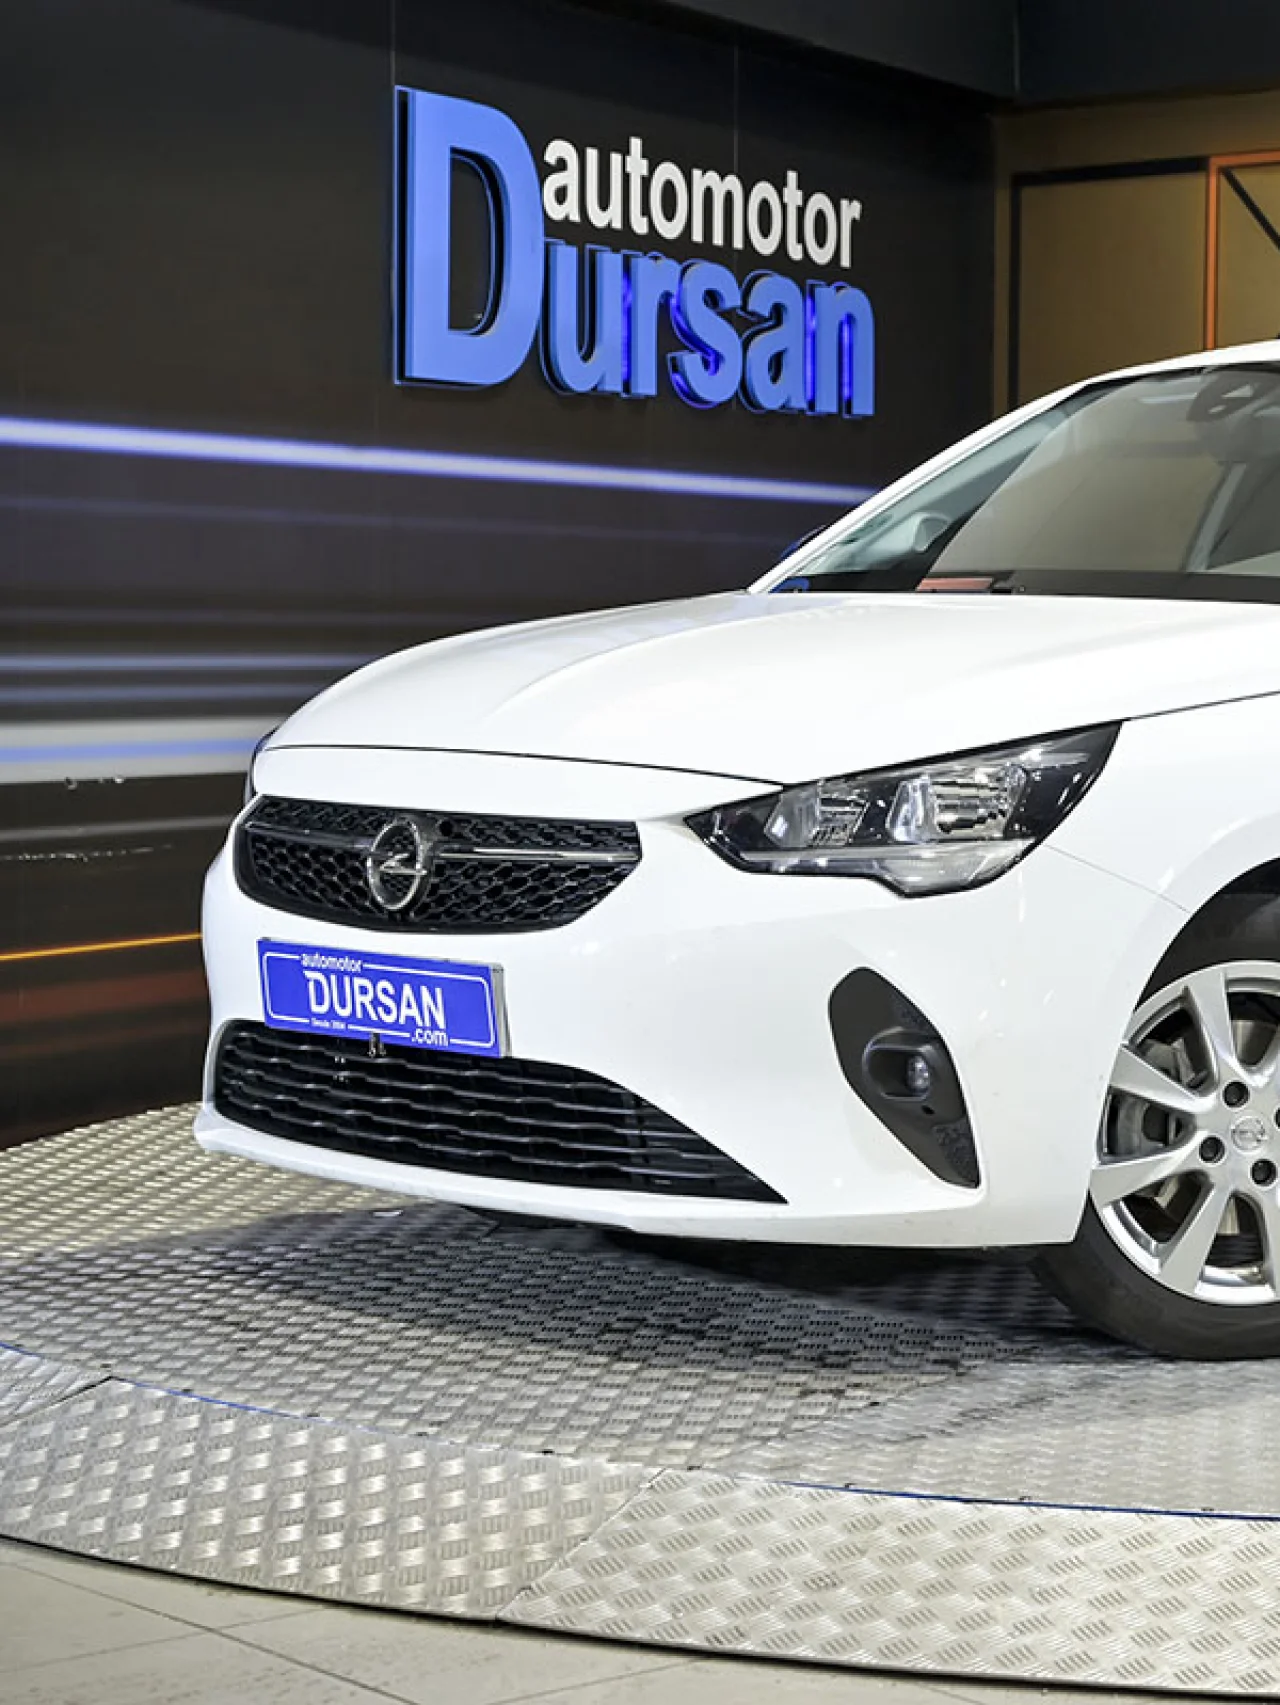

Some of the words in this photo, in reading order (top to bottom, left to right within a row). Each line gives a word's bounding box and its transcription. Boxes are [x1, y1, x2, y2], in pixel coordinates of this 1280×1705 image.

[543, 136, 862, 268] automotor
[394, 85, 875, 418] Dursan
[301, 953, 363, 973] automotor
[303, 970, 447, 1030] DURSAN
[412, 1028, 449, 1047] .com
